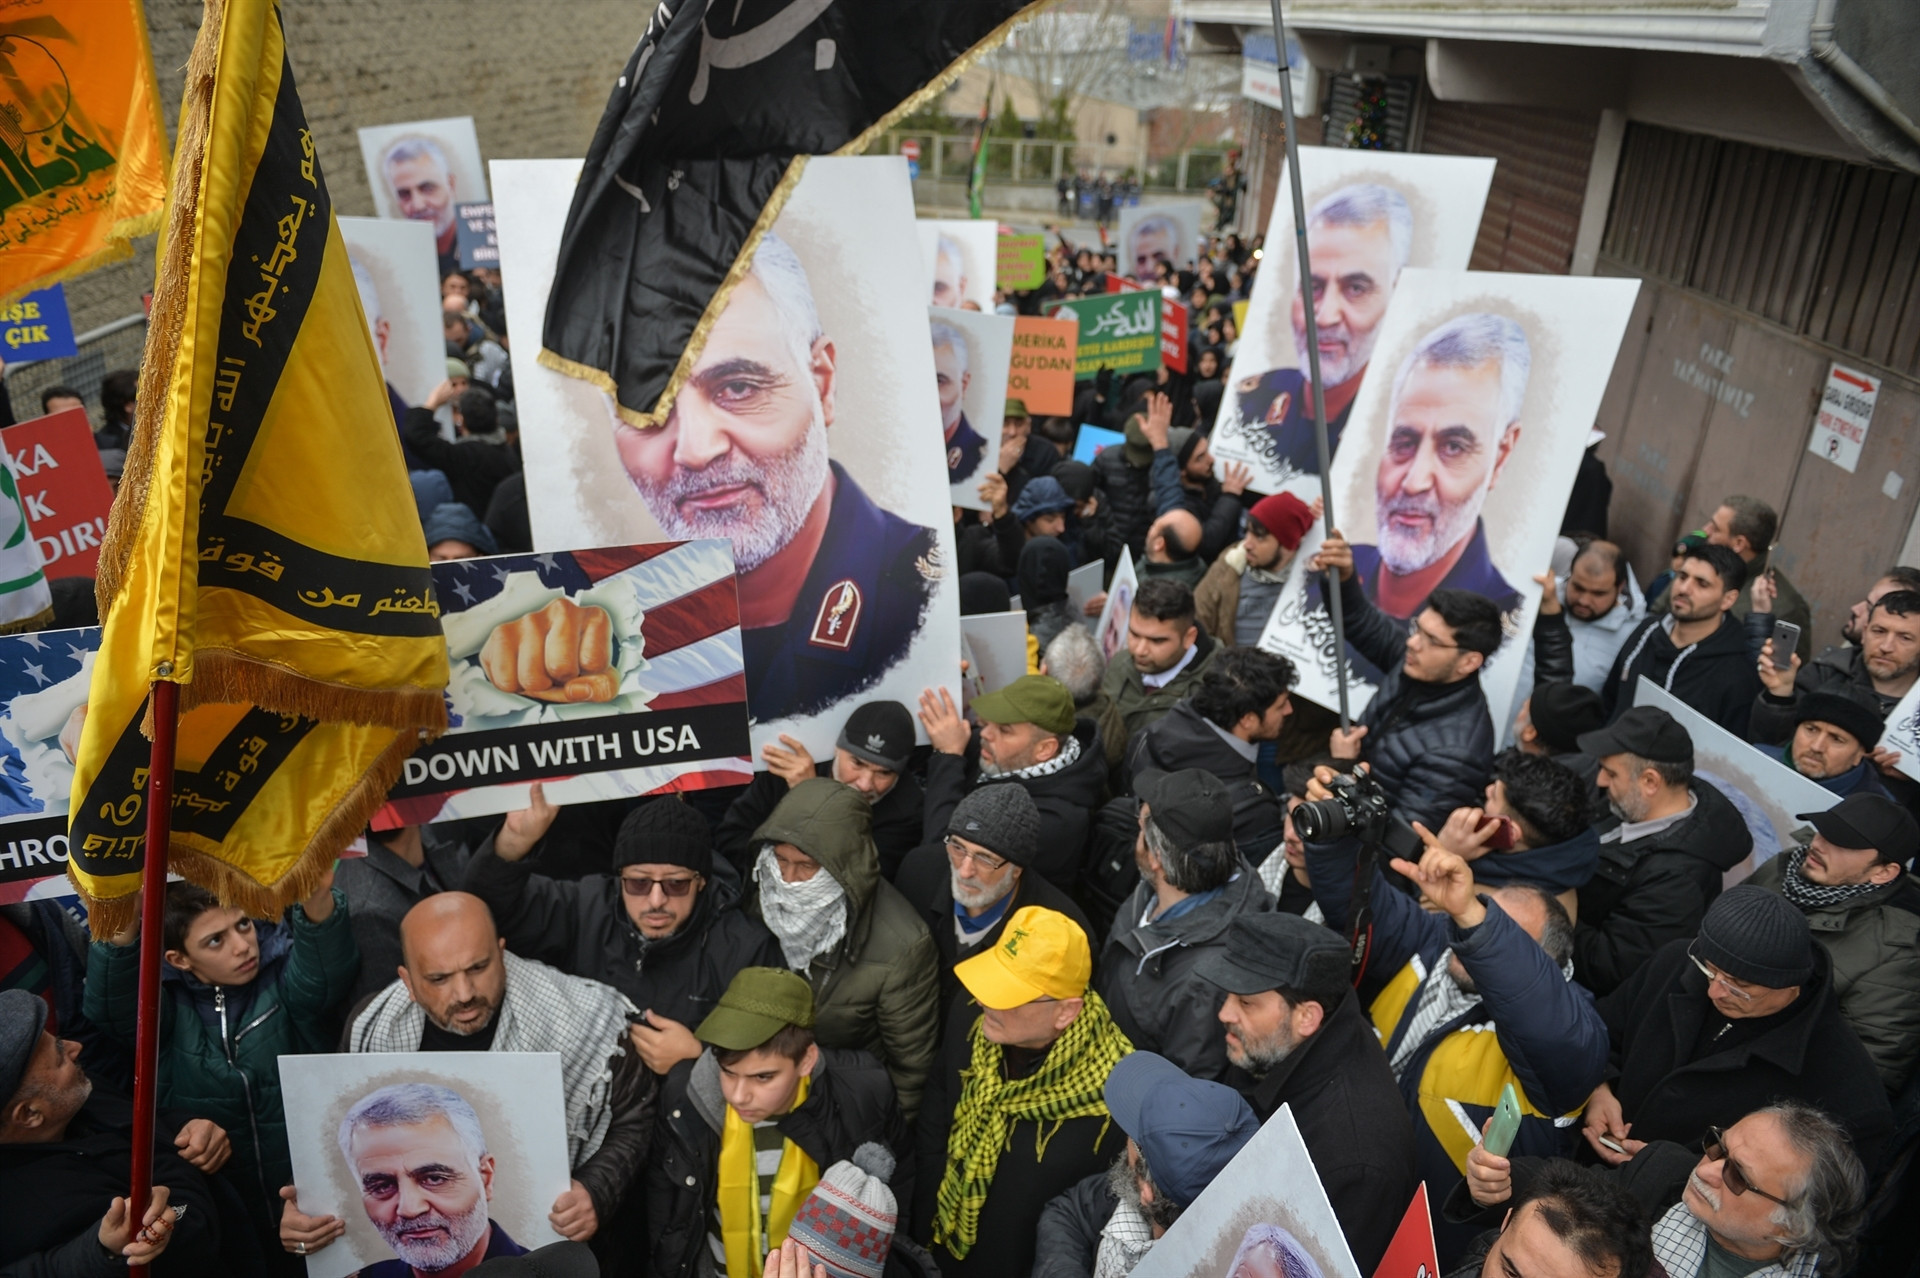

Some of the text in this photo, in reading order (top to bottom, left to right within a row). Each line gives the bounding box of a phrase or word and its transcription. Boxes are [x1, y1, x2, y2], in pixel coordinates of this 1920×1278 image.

[242, 194, 316, 349] يعذبهم
[5, 324, 51, 350] ÇIK
[215, 355, 246, 412] الله
[1009, 375, 1032, 390] OL
[198, 535, 286, 583] قوة
[296, 586, 362, 609] من
[214, 735, 269, 793] قوة
[402, 724, 701, 786] DOWN WITH USA
